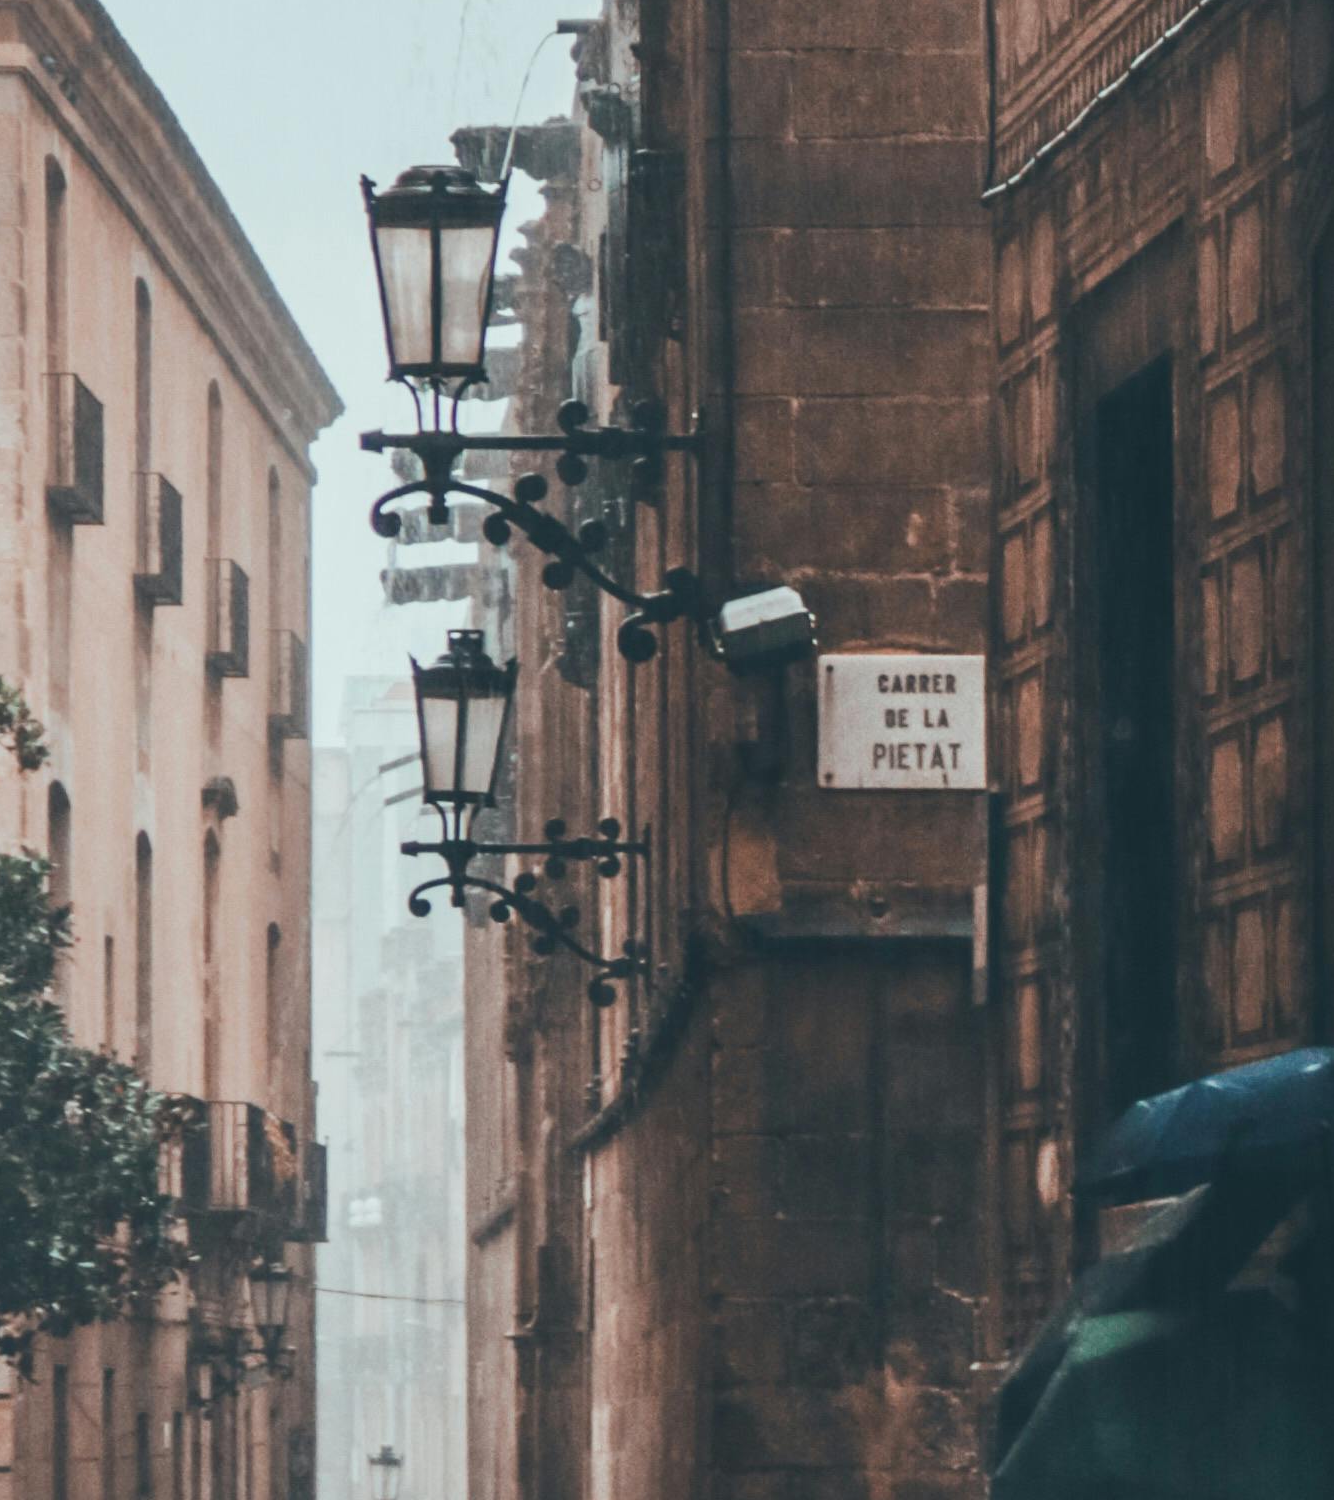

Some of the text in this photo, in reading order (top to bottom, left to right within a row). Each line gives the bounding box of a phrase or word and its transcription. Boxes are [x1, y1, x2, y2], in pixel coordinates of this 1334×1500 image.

[878, 674, 957, 694] CARRER
[885, 708, 949, 729] DE LA
[873, 743, 961, 770] PIETAT
